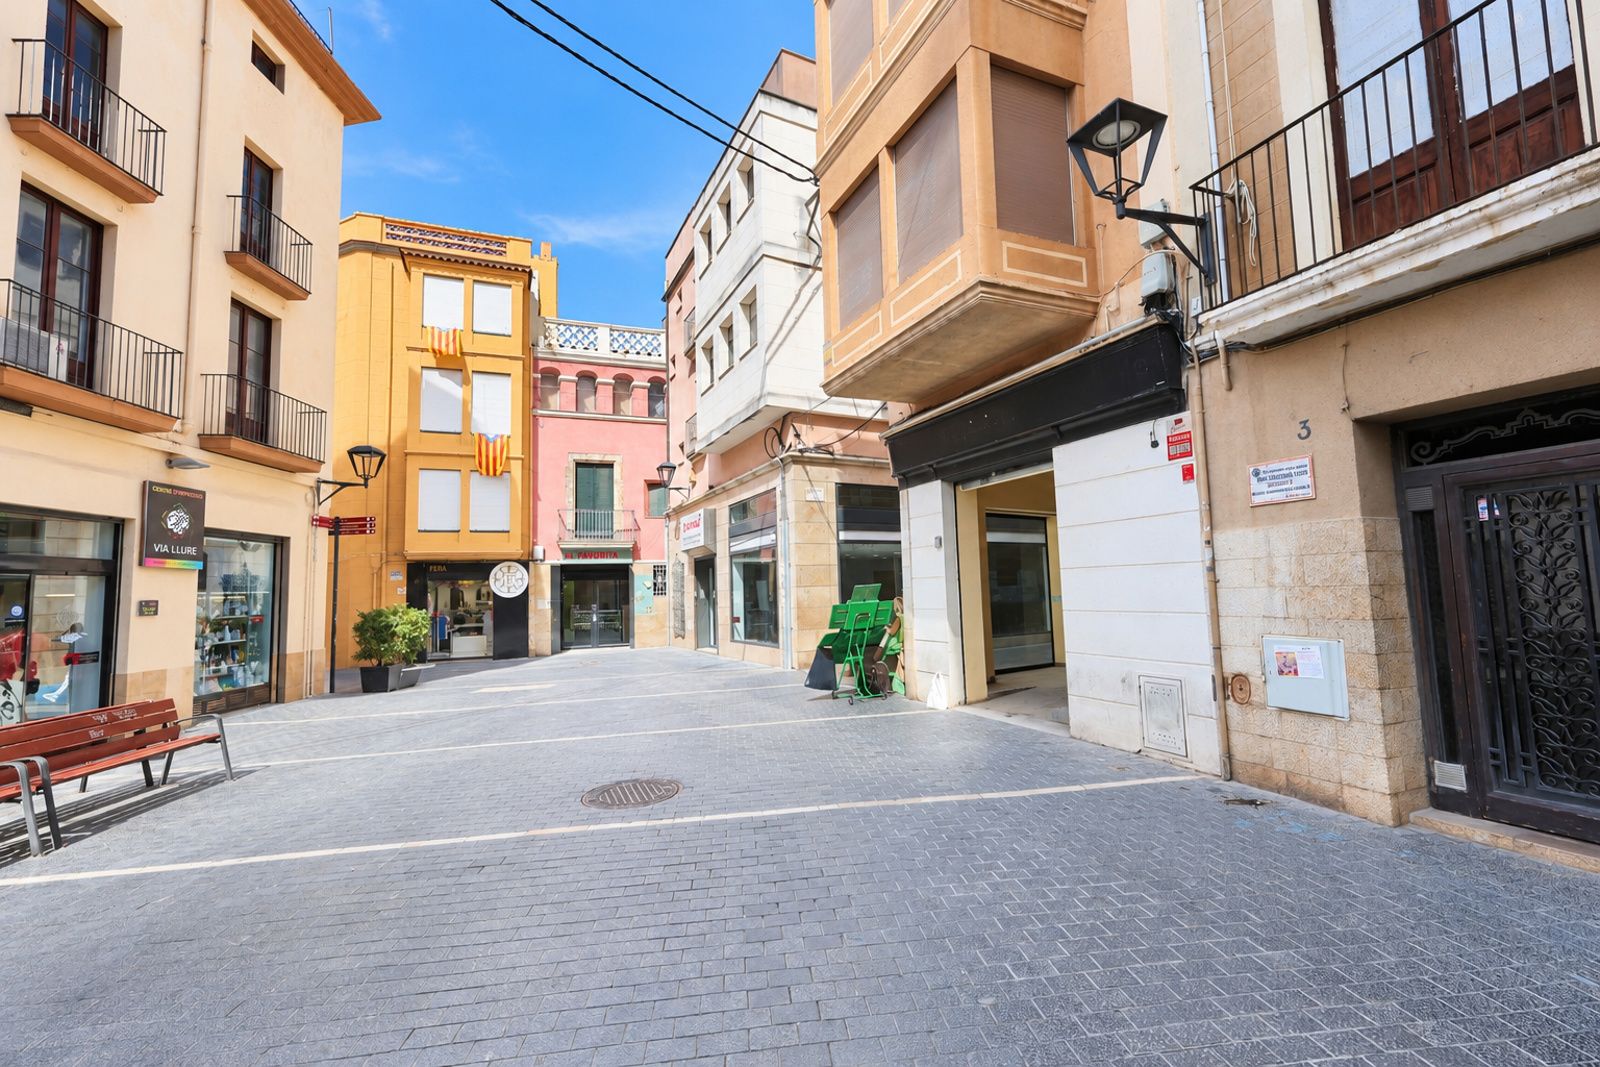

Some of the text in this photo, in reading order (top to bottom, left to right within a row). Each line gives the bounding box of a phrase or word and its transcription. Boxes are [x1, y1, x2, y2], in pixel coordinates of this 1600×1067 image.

[1297, 418, 1311, 440] 3
[153, 543, 197, 555] VIA LLURE
